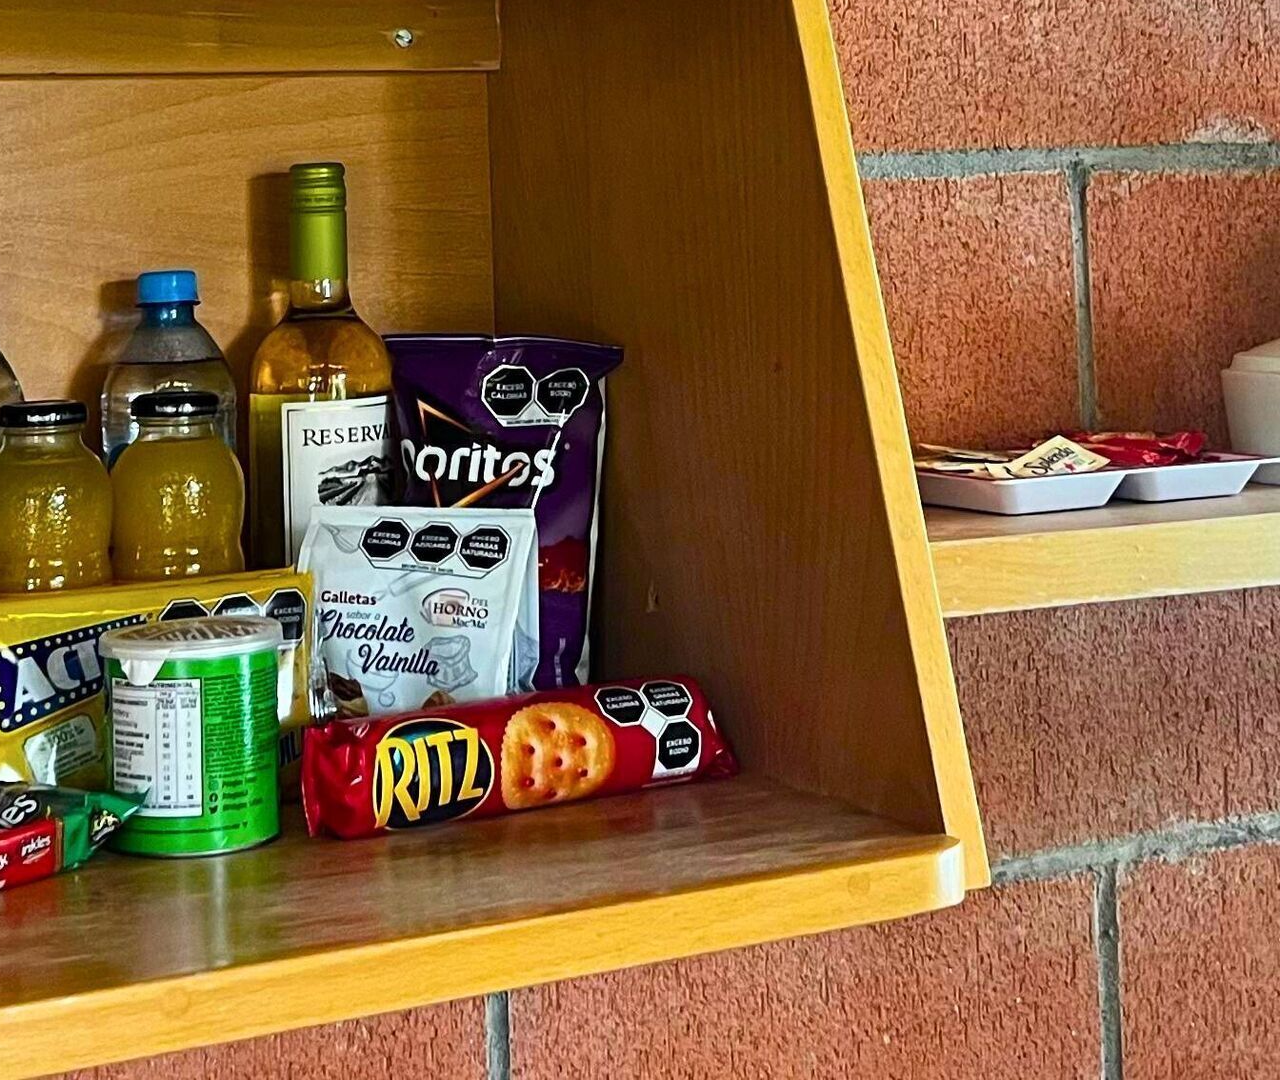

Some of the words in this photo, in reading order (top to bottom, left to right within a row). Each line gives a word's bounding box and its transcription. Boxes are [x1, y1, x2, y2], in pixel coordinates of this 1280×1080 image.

[321, 590, 377, 606] Galletas
[432, 602, 489, 619] HORNO
[316, 607, 415, 643] Chocolate
[346, 610, 372, 620] sabor
[358, 643, 441, 676] Vainilla
[374, 728, 484, 829] RITZ
